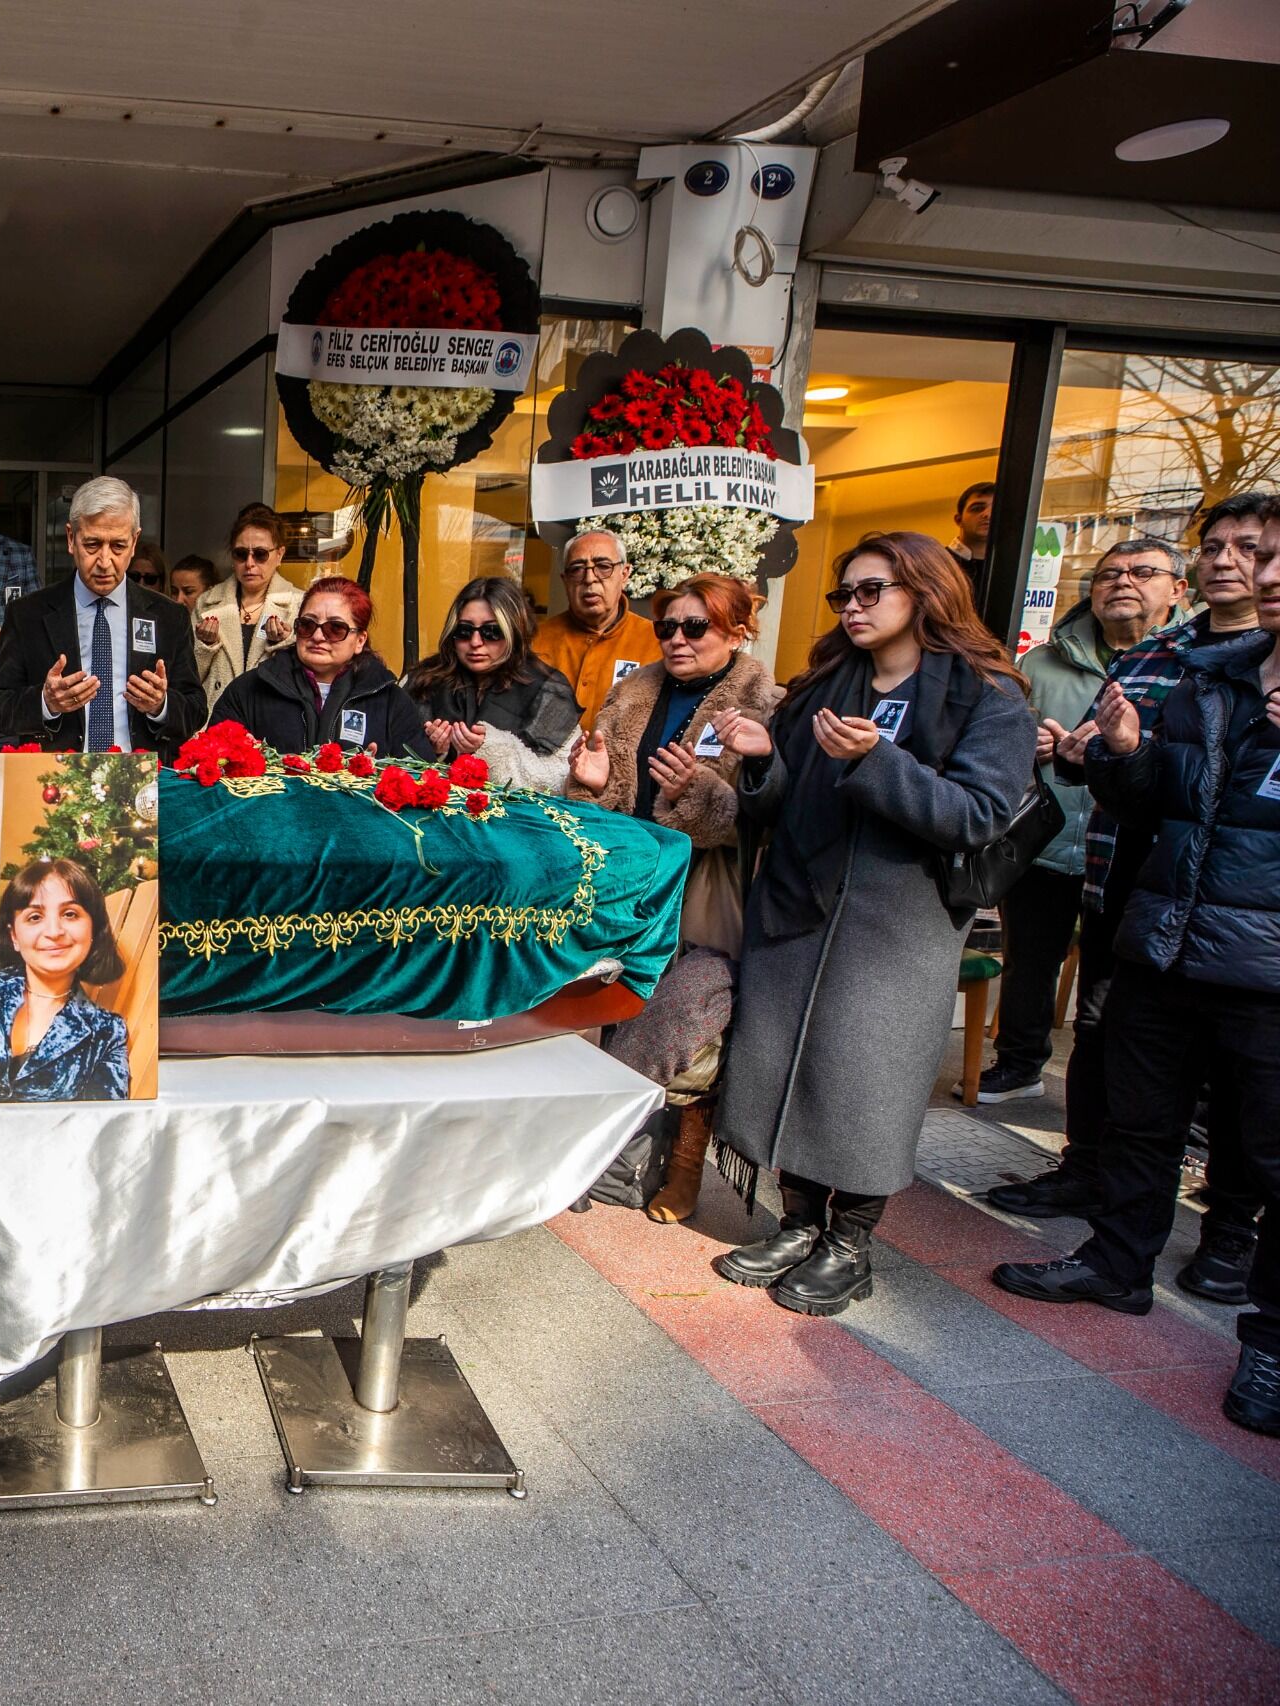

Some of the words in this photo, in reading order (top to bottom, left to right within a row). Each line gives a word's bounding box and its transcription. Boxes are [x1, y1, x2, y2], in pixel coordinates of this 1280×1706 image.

[704, 169, 715, 185] 2
[328, 328, 354, 352] FİLİZ
[360, 329, 440, 354] CERİTOĞLU
[447, 336, 494, 358] SENGEL
[327, 353, 345, 368] EFES
[349, 354, 389, 374] SELÇUK
[394, 353, 447, 373] BELEDİYE
[451, 358, 489, 378] BAŞKANI
[629, 451, 711, 482] KARABAĞLAR
[713, 453, 753, 480] BELEDİYE
[726, 482, 776, 509] KINAY
